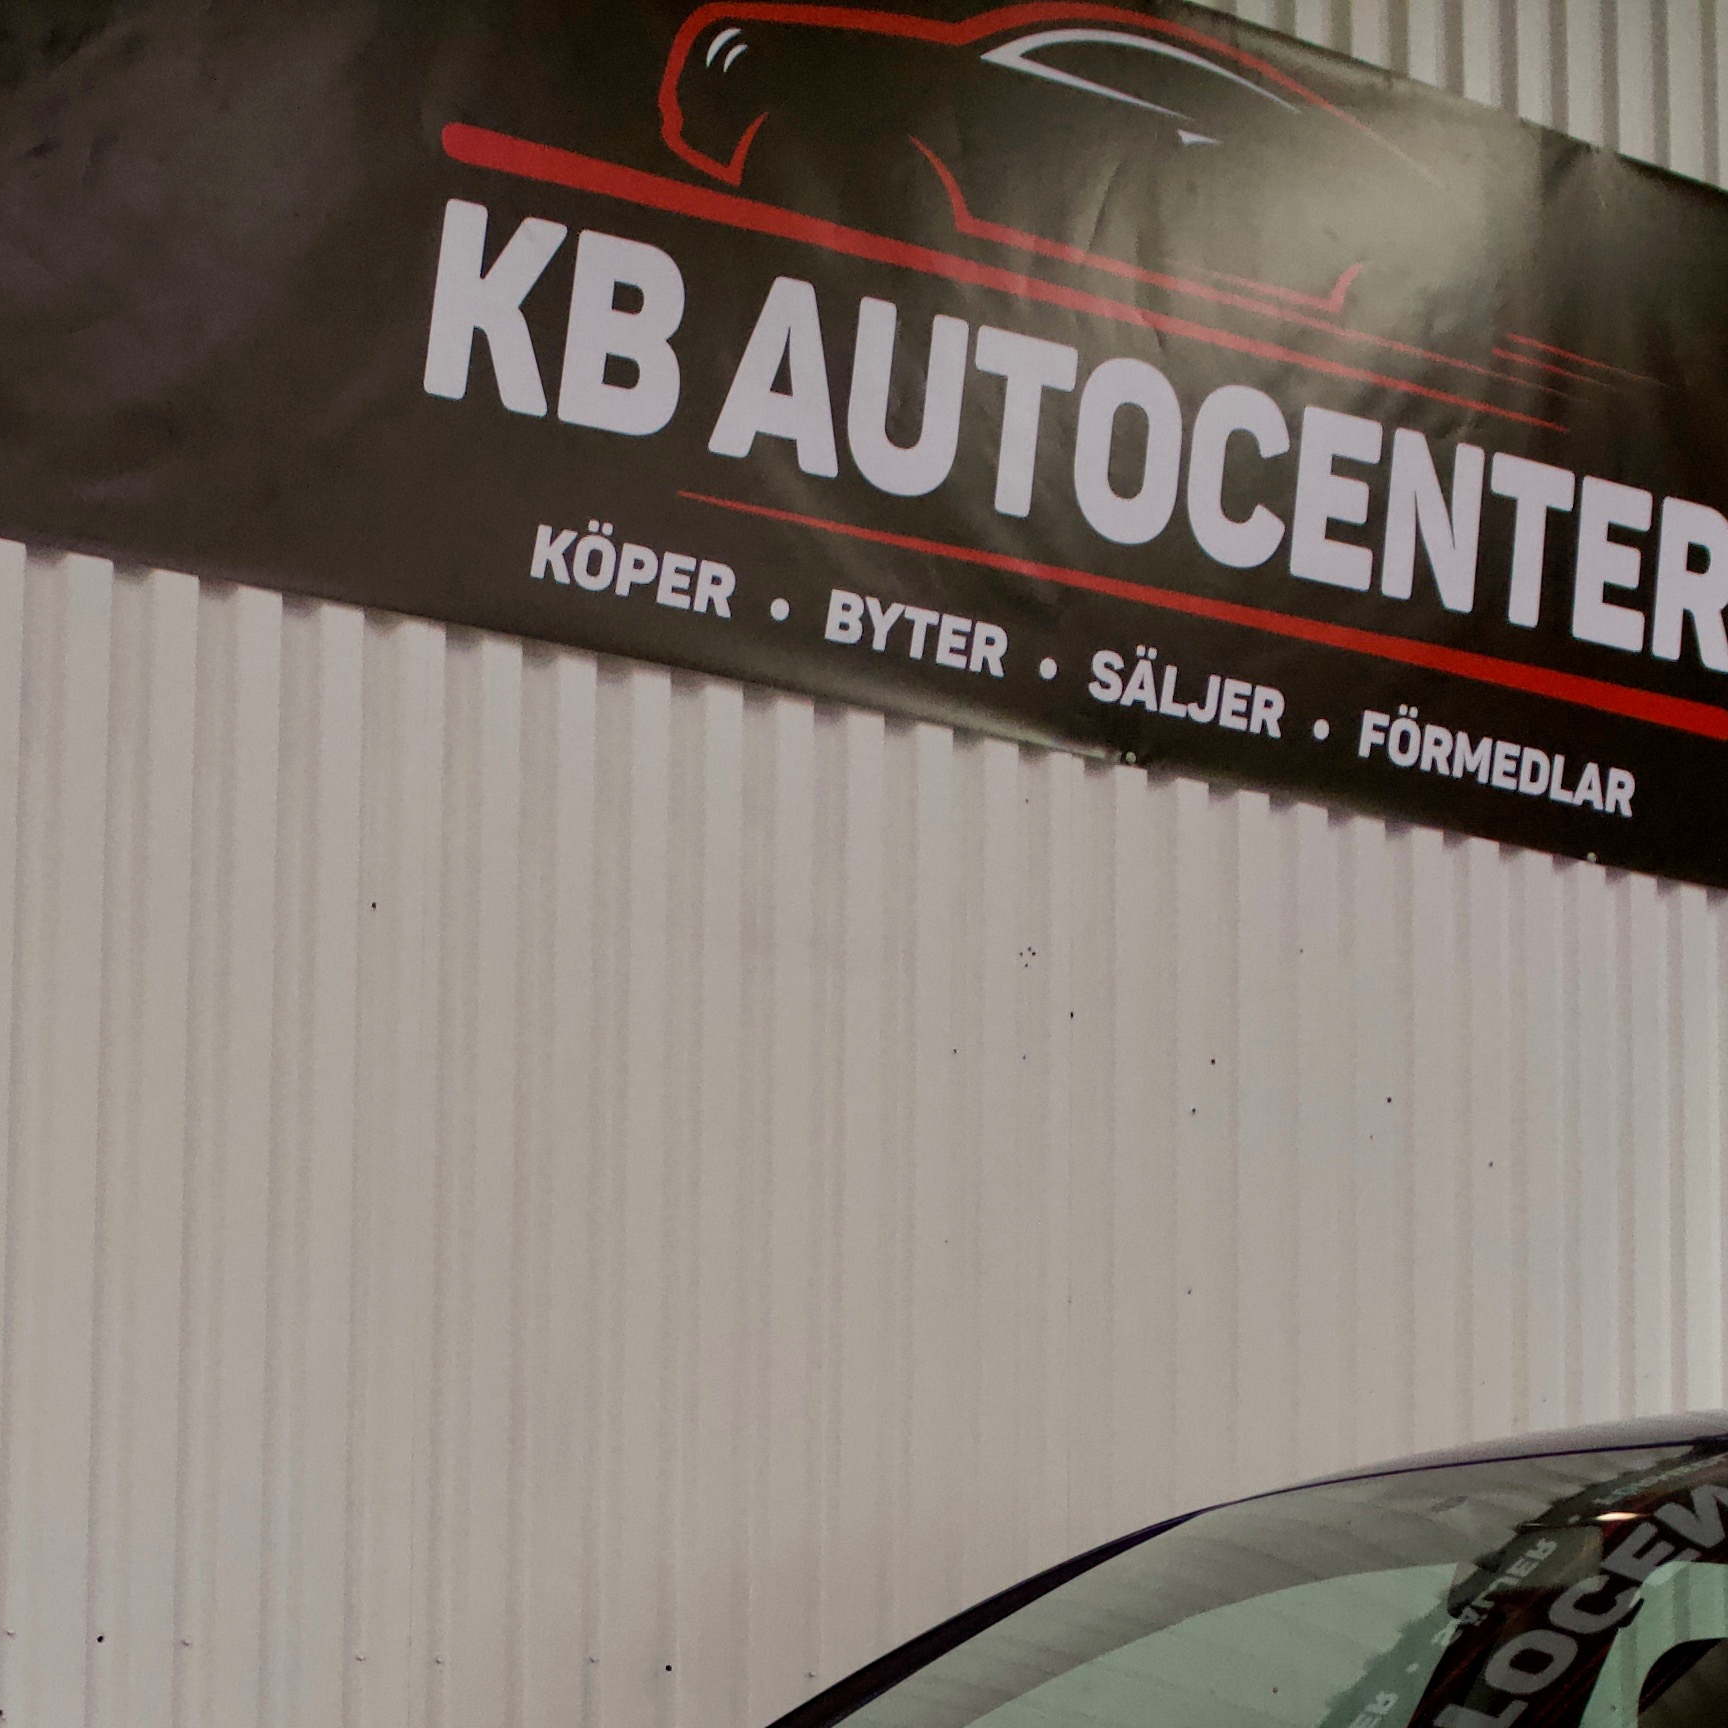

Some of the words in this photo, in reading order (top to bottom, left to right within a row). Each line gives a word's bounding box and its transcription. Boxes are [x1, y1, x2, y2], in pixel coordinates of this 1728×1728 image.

[424, 199, 684, 435] KB
[530, 520, 735, 618] KÖPER
[825, 589, 1007, 677] BYTER
[1089, 645, 1284, 738] SÄLJER
[1359, 704, 1635, 817] FÖRMEDLAR
